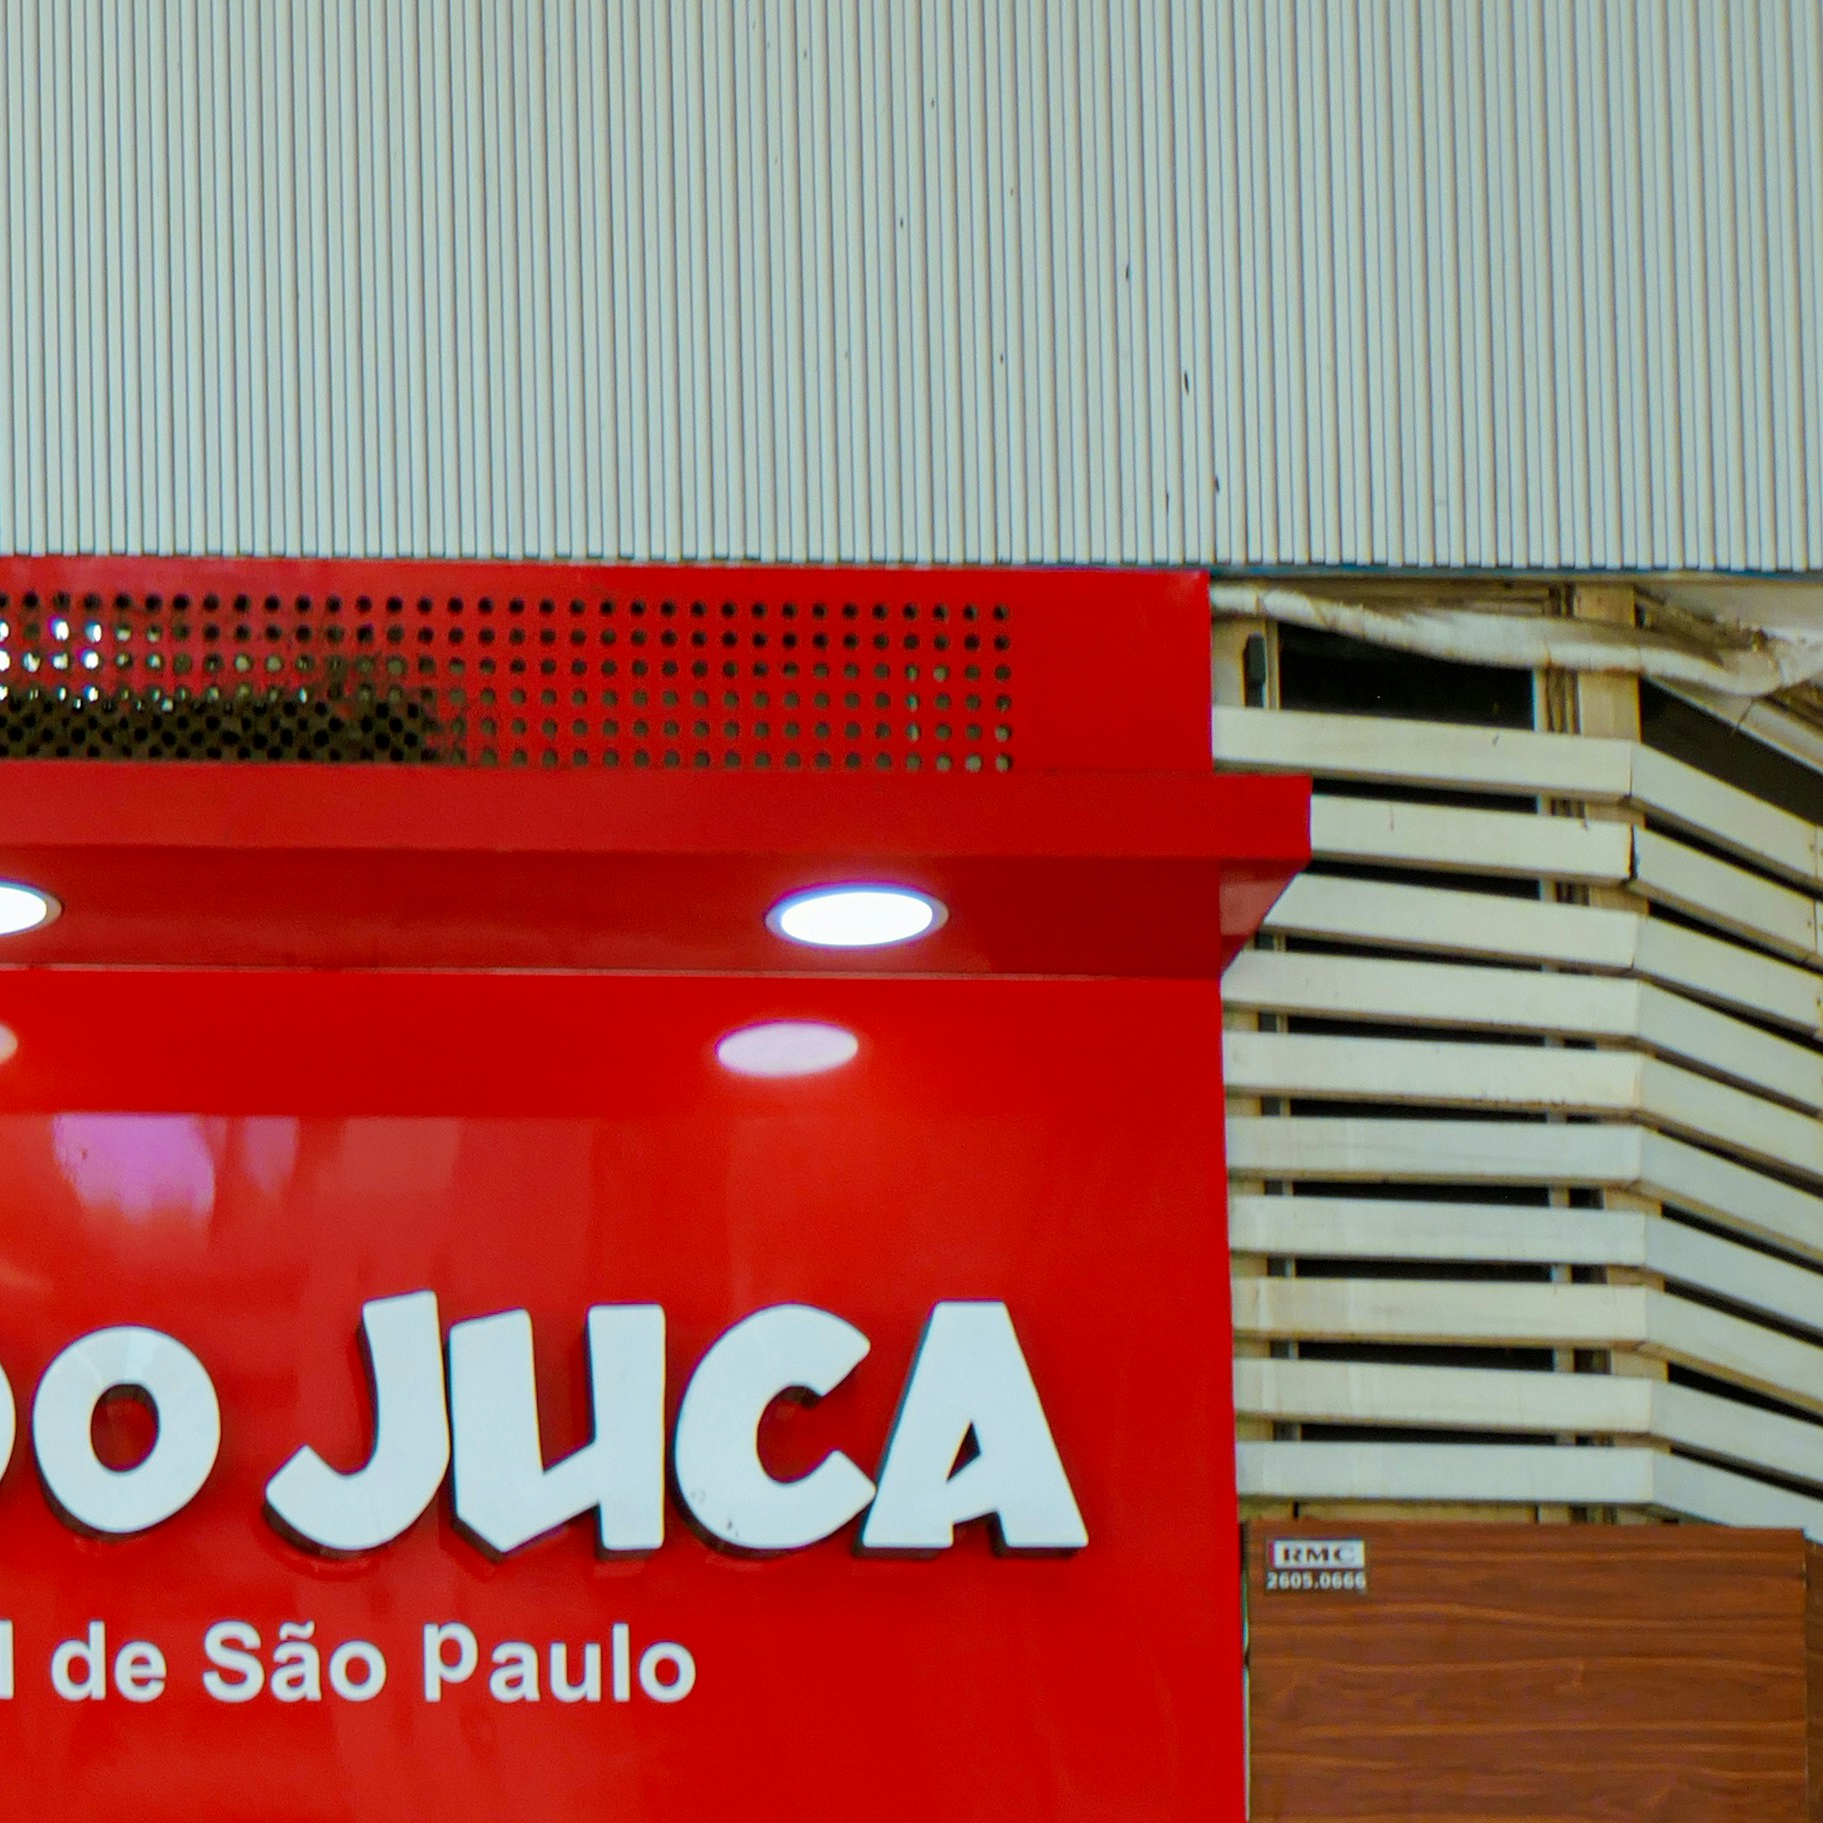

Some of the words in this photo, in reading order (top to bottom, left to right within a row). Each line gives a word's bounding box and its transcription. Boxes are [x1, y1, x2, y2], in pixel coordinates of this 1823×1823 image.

[263, 1289, 1089, 1555] JUCA
[50, 1620, 167, 1702] de
[201, 1620, 386, 1703] São
[423, 1621, 697, 1704] Paulo
